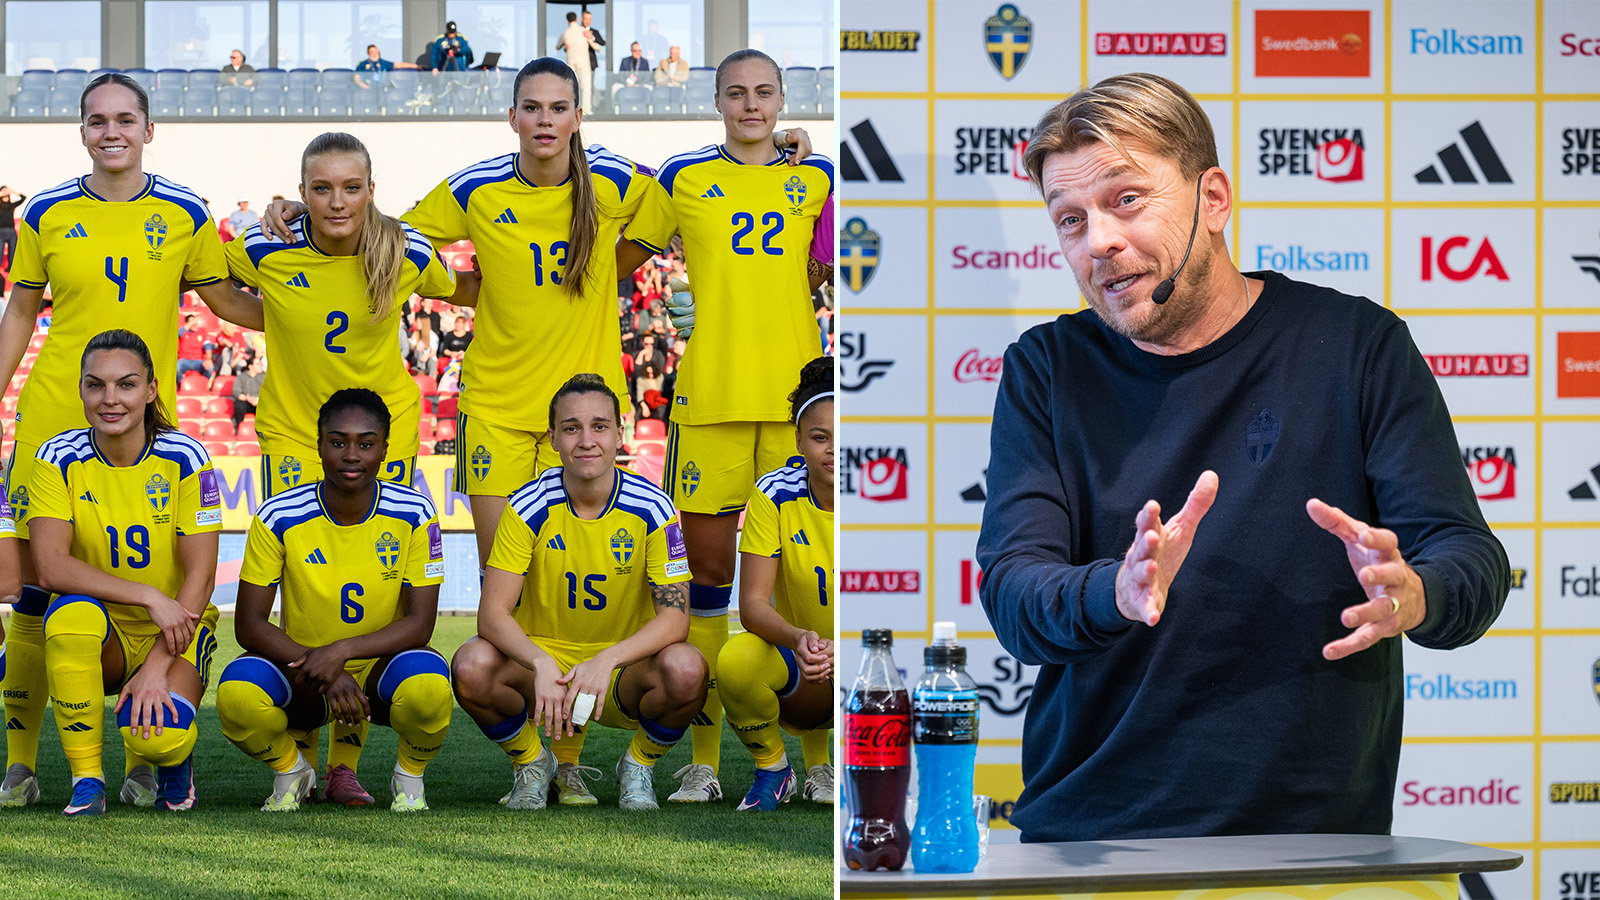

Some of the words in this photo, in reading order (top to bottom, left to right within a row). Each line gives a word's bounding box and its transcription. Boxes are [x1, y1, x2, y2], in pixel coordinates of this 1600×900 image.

[1097, 34, 1225, 54] BAUHAUS
[1262, 36, 1338, 51] Swedbank
[1410, 28, 1523, 55] Folksam
[956, 127, 1034, 149] SVENS
[1259, 128, 1364, 150] SVENSKA
[1562, 128, 1600, 150] SVE
[956, 152, 1009, 174] SPEL
[1259, 153, 1313, 175] SPEL
[1562, 153, 1600, 175] SPE
[731, 212, 785, 256] 22
[530, 241, 569, 287] 13
[952, 246, 1062, 269] Scandic
[1257, 245, 1369, 272] Folksam
[1421, 236, 1510, 282] ICA
[105, 256, 129, 302] 4
[324, 311, 349, 354] 2
[840, 333, 865, 360] SJ
[106, 525, 151, 569] 19
[565, 571, 607, 611] 15
[814, 565, 834, 606] 1
[840, 572, 919, 591] HAUS
[341, 583, 365, 624] 6
[995, 657, 1021, 684] SJ
[1405, 674, 1516, 699] Folksam
[914, 702, 975, 711] POWERADE
[1402, 779, 1520, 806] Scandic
[1560, 872, 1600, 894] SVE
